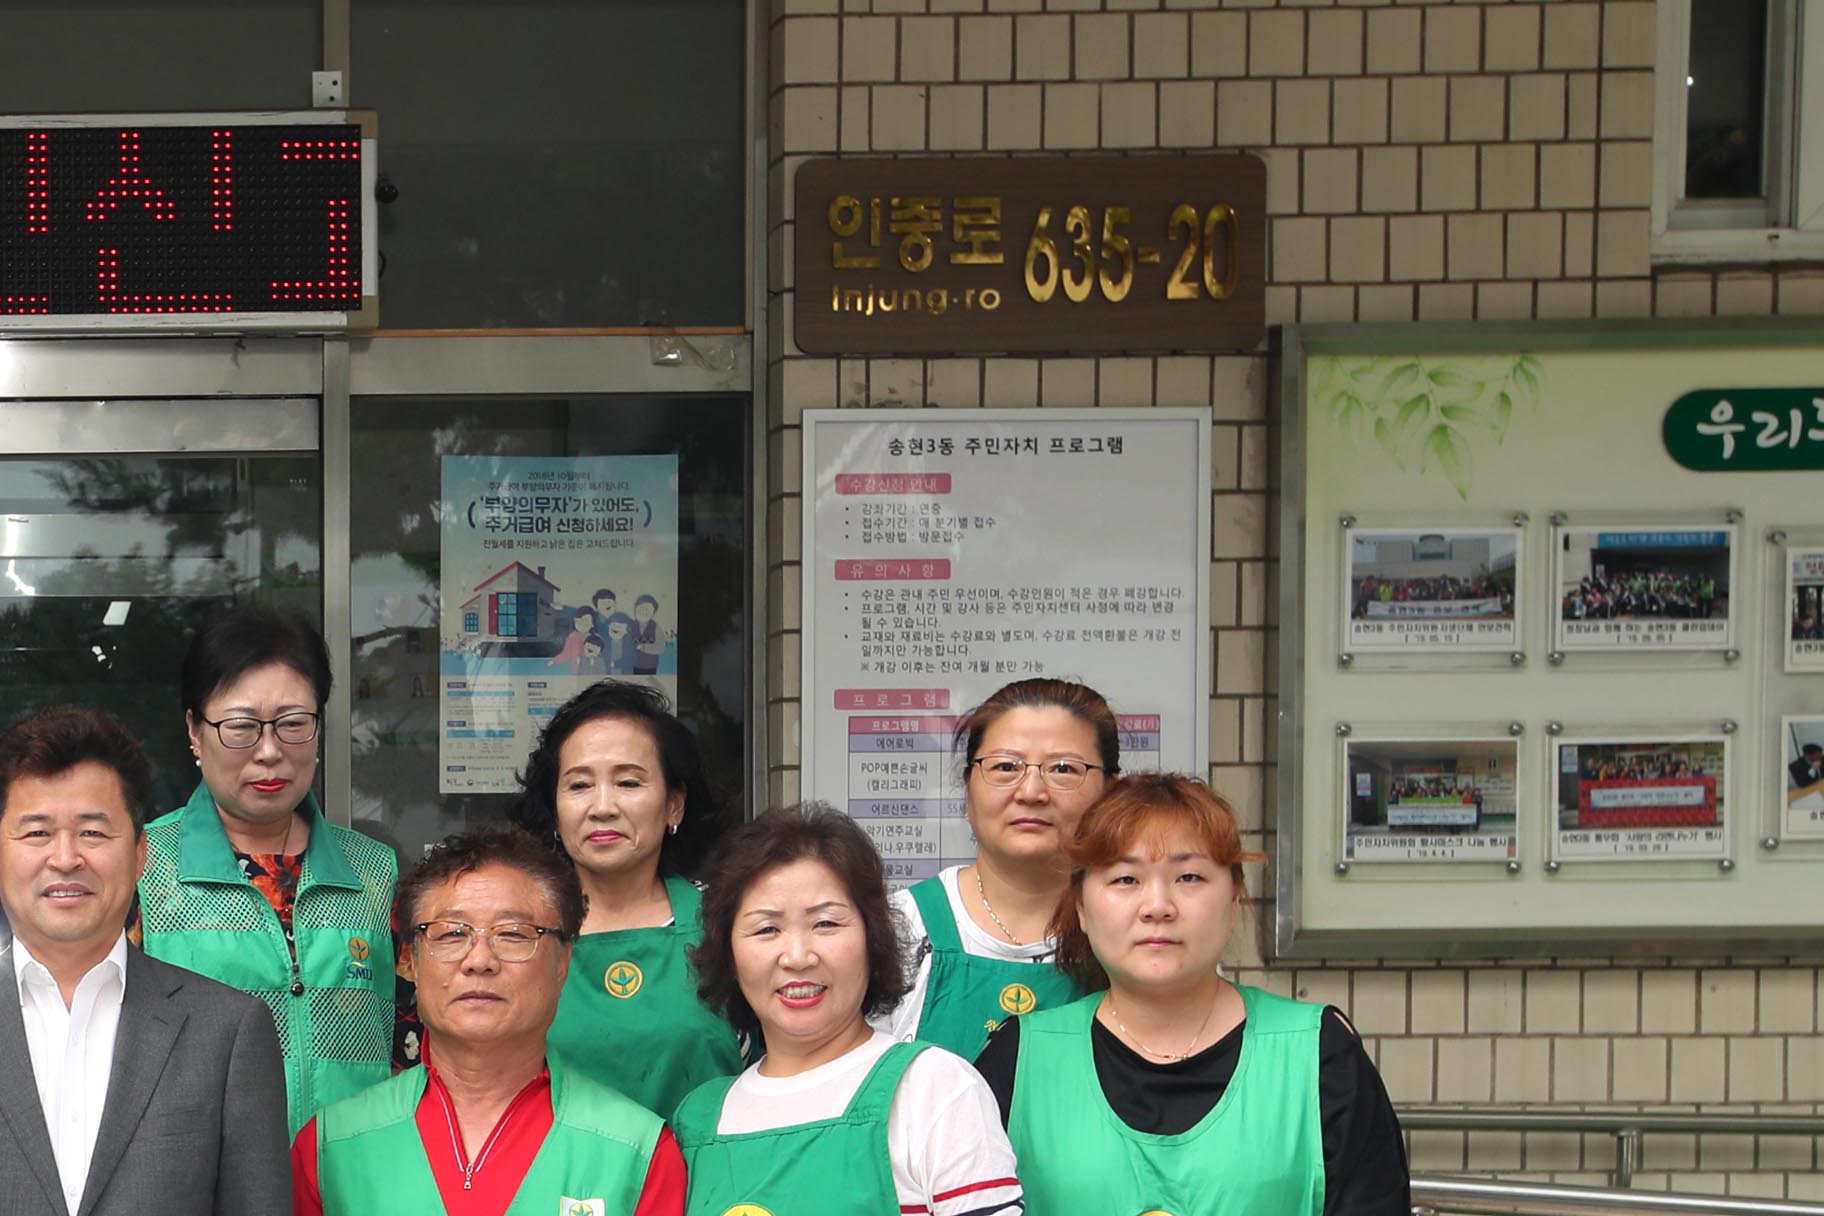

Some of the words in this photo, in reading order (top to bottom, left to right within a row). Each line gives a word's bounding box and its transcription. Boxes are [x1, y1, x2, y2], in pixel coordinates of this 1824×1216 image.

[828, 195, 1004, 272] 인중로
[1024, 203, 1239, 302] 635-20
[889, 437, 955, 455] 송현3동
[965, 437, 1039, 455] 주민자치
[1050, 437, 1123, 455] 프로그램
[485, 516, 550, 533] 주거급여
[557, 519, 633, 532] 신청하세요!
[863, 517, 907, 529] 접수기간
[974, 517, 996, 529] 접수
[863, 531, 907, 543] 접수방법
[928, 588, 949, 601] 주민
[872, 719, 919, 731] 프로그램명
[876, 738, 914, 749] 에어로빅
[872, 804, 919, 815] 어르신댄스
